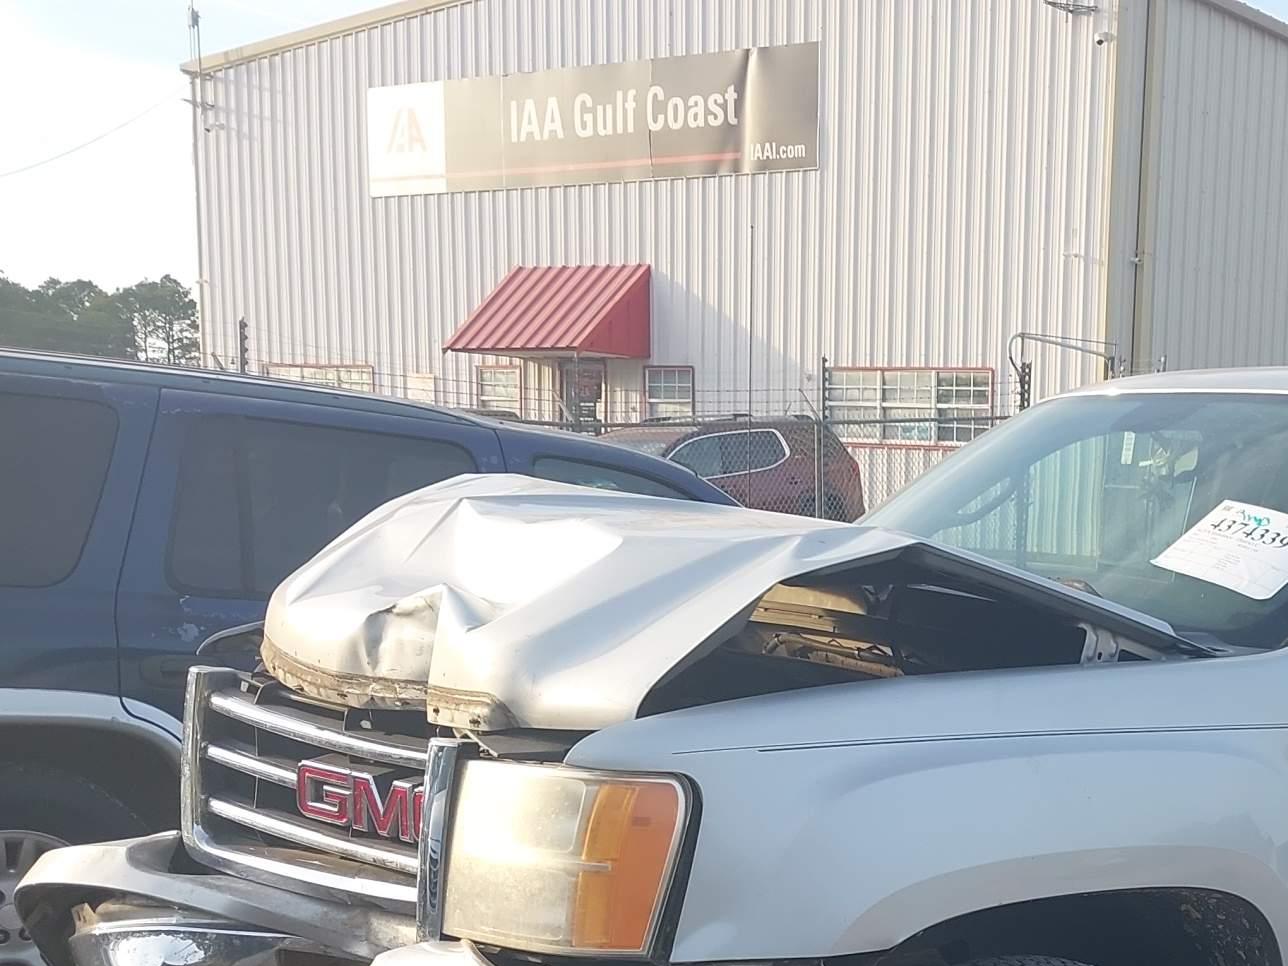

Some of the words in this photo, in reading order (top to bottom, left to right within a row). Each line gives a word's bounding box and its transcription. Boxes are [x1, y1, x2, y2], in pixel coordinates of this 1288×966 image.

[510, 96, 565, 143] IAA
[574, 88, 637, 138] Gulf
[646, 84, 738, 131] Coast
[296, 760, 424, 843] GM
